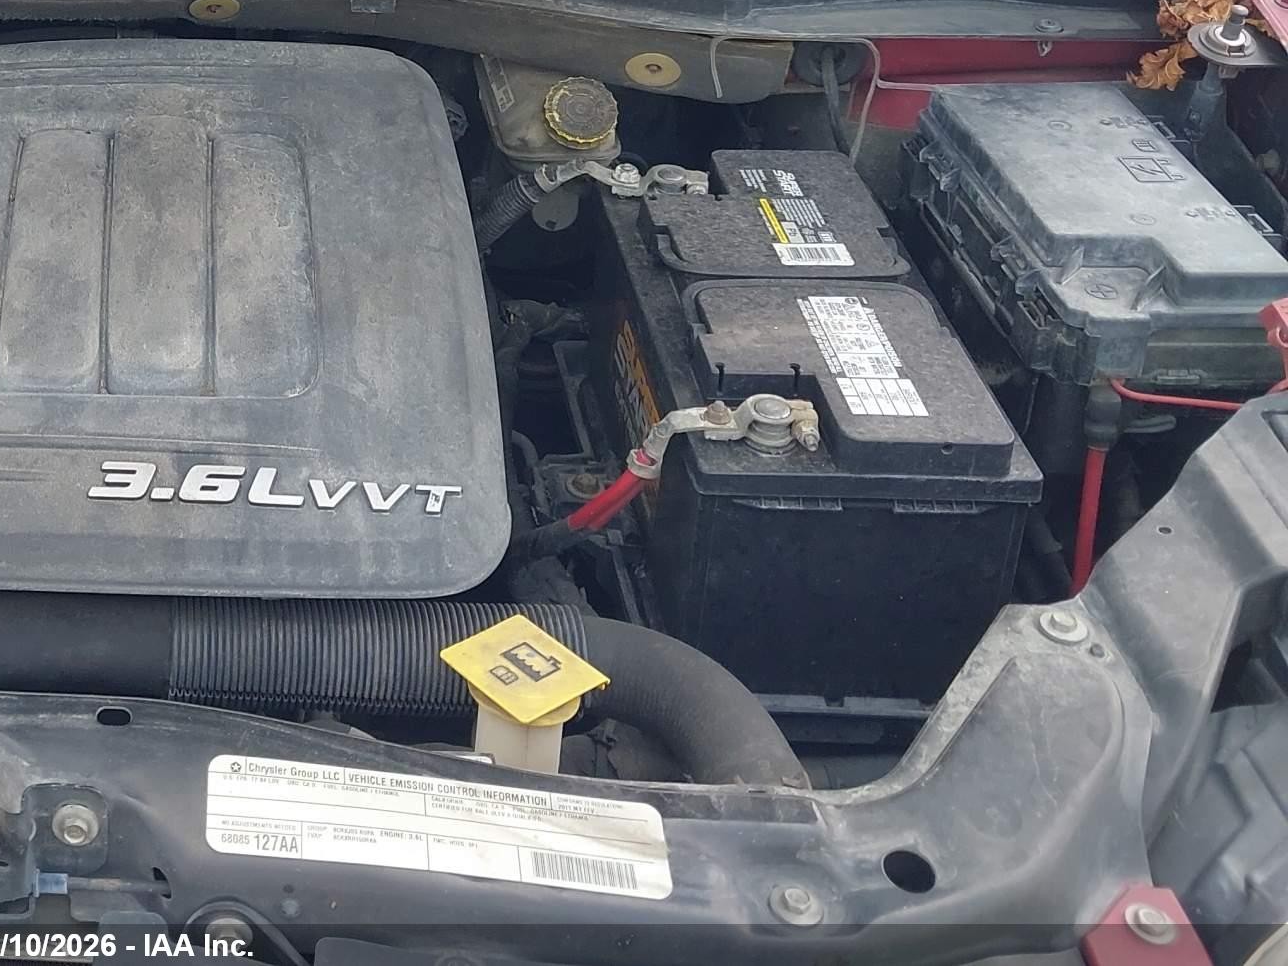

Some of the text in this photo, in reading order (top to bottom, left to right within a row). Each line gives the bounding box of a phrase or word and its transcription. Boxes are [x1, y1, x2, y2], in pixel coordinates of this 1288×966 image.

[772, 169, 796, 197] START
[786, 172, 804, 197] SUPER
[88, 461, 463, 515] 3.6L VVT
[248, 762, 341, 781] Chrysler Group LLC
[348, 773, 387, 787] VEHICLE
[390, 777, 434, 792] EMISSION
[437, 783, 481, 798] CONTROL
[483, 789, 548, 807] INFORMATION
[220, 833, 250, 845] 68085
[253, 833, 299, 854] 127AA
